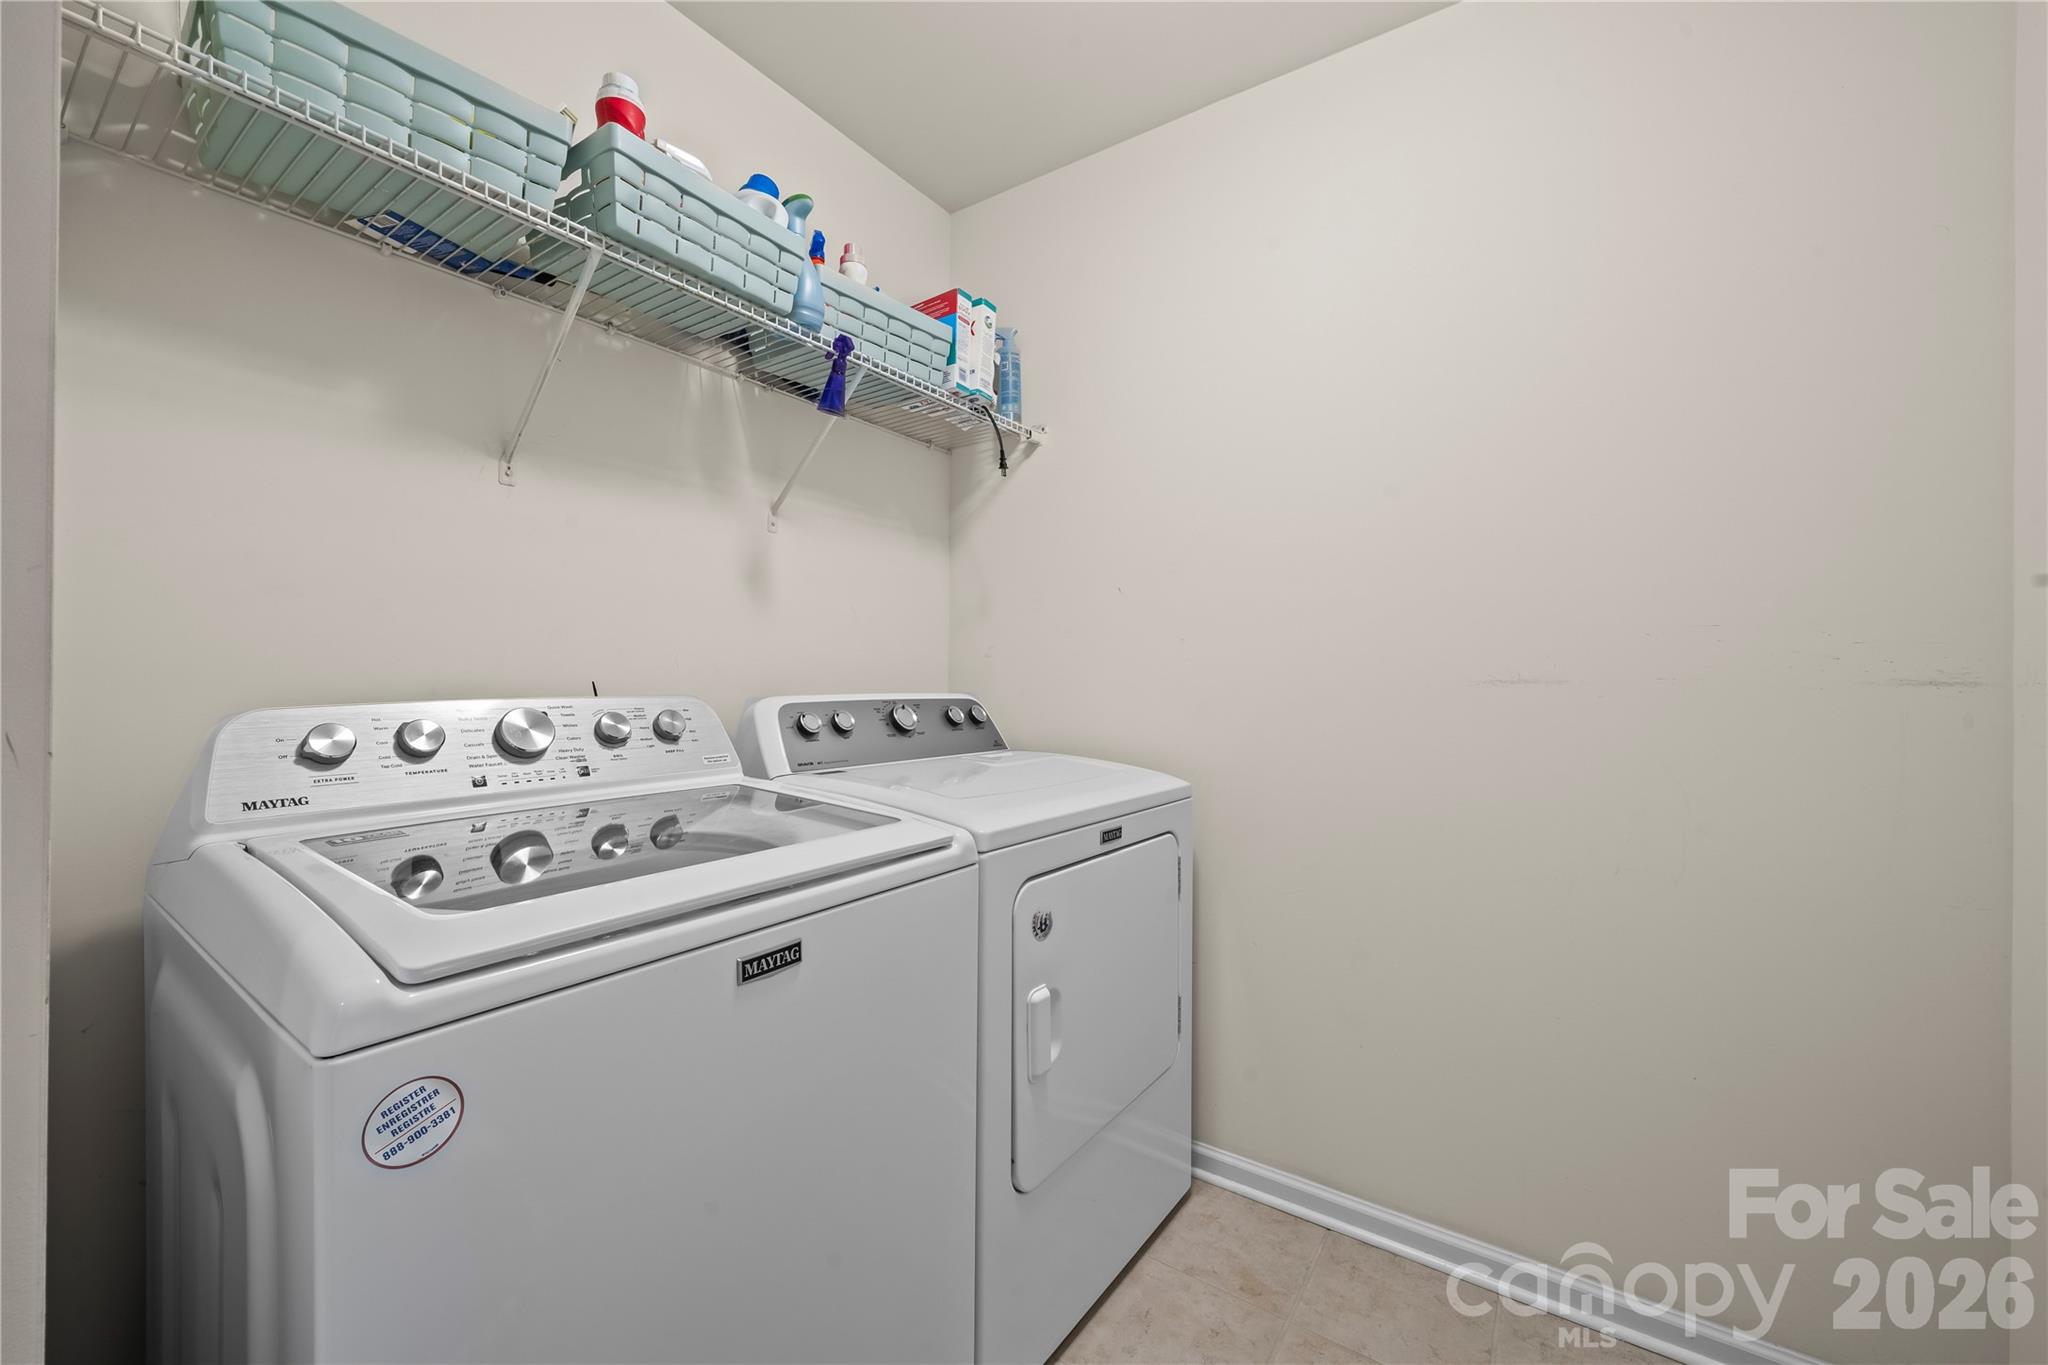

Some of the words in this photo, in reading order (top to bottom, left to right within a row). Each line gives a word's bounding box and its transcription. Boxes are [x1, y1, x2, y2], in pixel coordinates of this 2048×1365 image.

[241, 796, 309, 812] MAYTAG
[744, 946, 800, 978] MAYTAG
[376, 1088, 440, 1135] ENREGISTRER
[380, 1085, 427, 1119] REGISTER
[382, 1106, 456, 1161] 888-900-3381
[390, 1102, 437, 1137] REGISTRE
